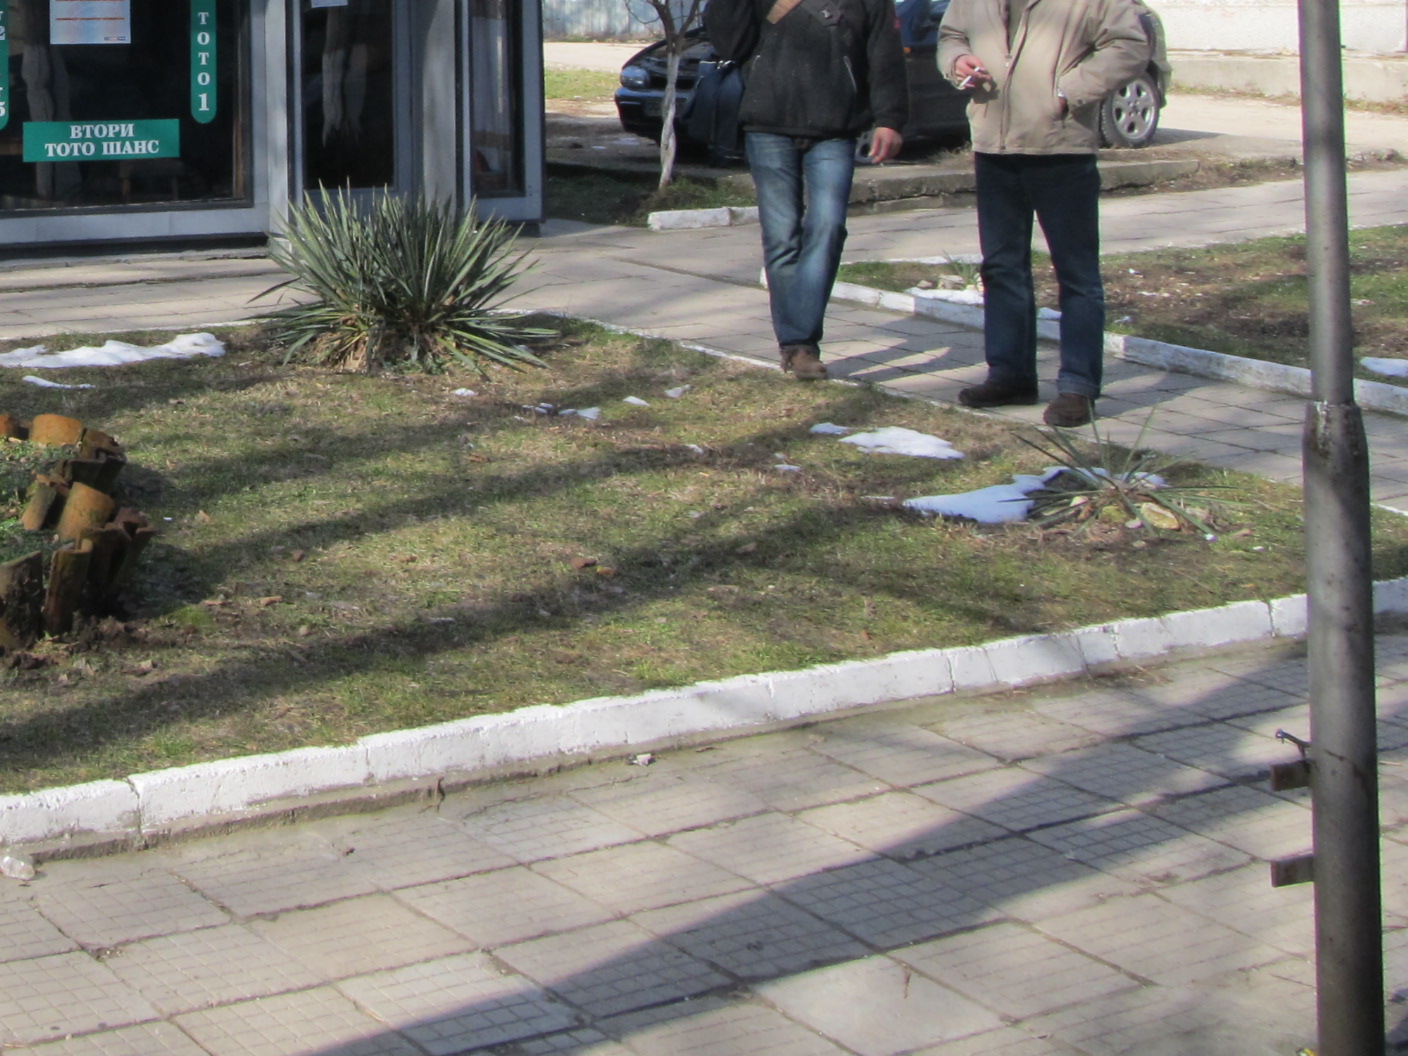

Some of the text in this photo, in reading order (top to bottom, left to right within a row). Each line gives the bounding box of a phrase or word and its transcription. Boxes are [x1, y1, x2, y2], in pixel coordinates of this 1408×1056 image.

[197, 12, 210, 85] ТОТО
[199, 93, 209, 110] 1
[70, 124, 134, 138] ВТОРИ
[45, 140, 158, 156] ТОТО ШАНС
